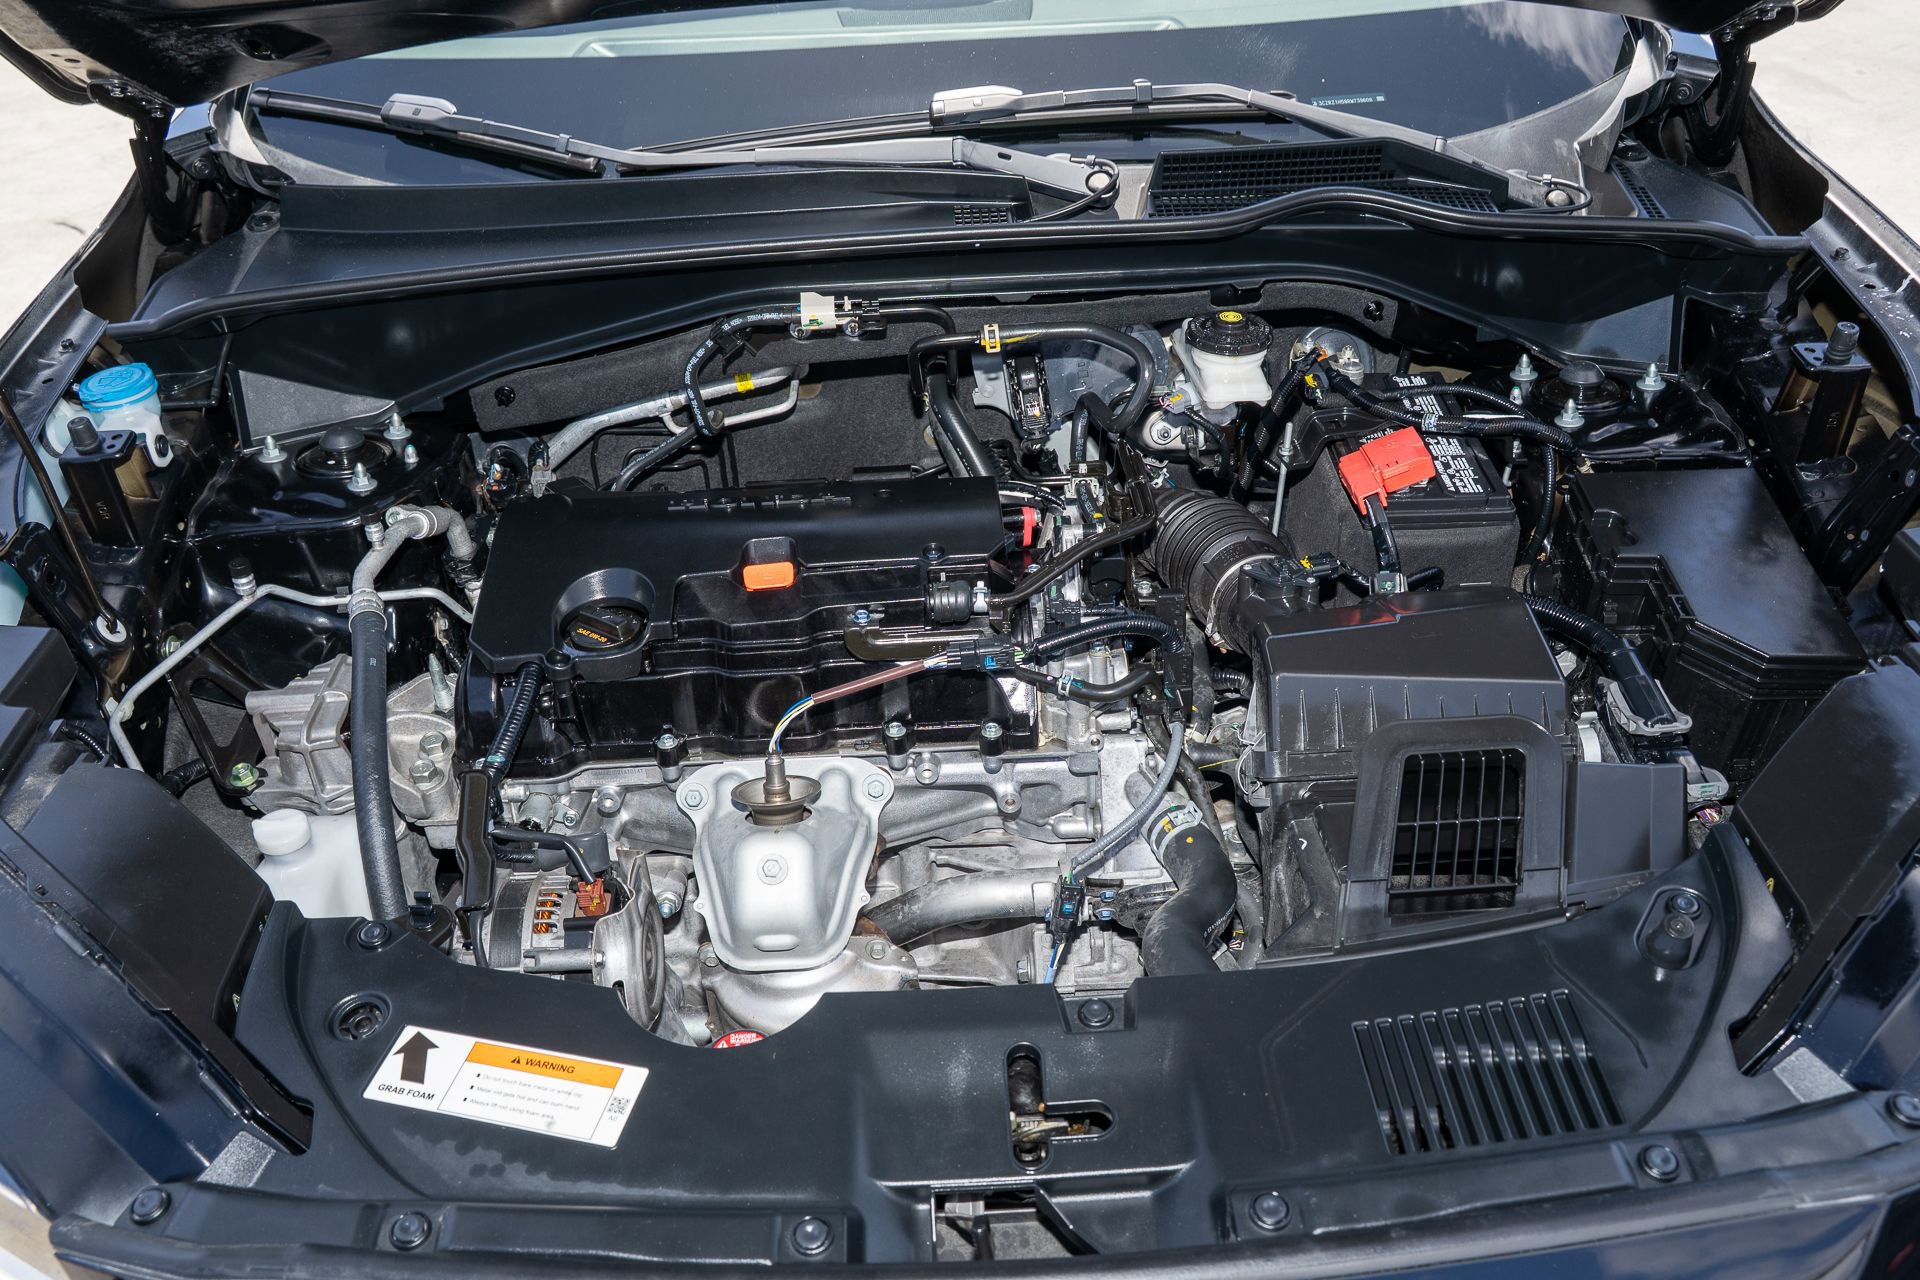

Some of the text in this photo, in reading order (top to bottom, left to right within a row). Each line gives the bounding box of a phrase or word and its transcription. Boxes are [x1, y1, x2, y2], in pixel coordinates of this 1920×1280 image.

[577, 628, 591, 636] SAE
[525, 1058, 575, 1074] WARNING
[378, 1084, 435, 1101] GRAB FOAM
